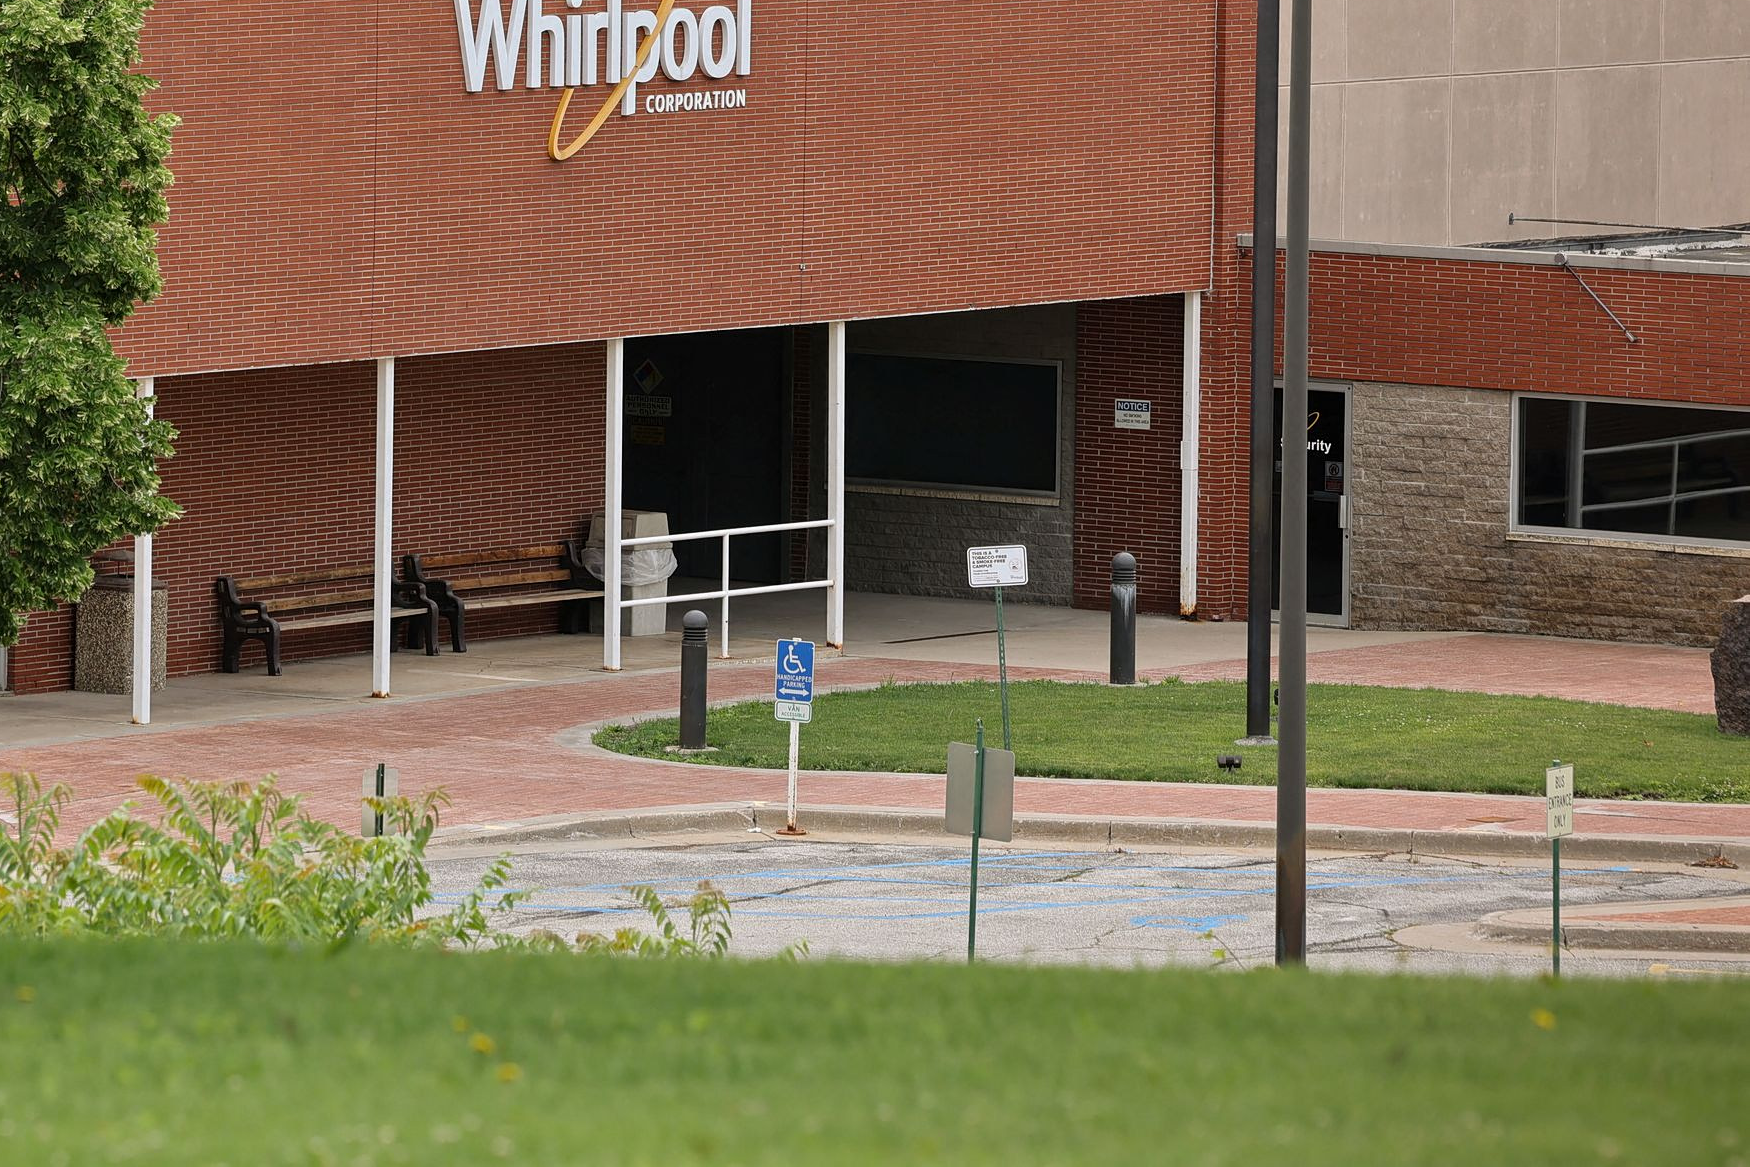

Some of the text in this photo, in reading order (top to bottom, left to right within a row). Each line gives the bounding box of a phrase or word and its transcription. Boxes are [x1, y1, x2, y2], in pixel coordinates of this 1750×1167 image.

[645, 89, 747, 113] CORPORATION
[1117, 402, 1148, 411] NOTICE
[777, 674, 812, 683] HANDICAPPED
[1555, 775, 1565, 789] BUS
[1549, 793, 1572, 810] ENTRANCE
[1554, 814, 1566, 828] ONLY
